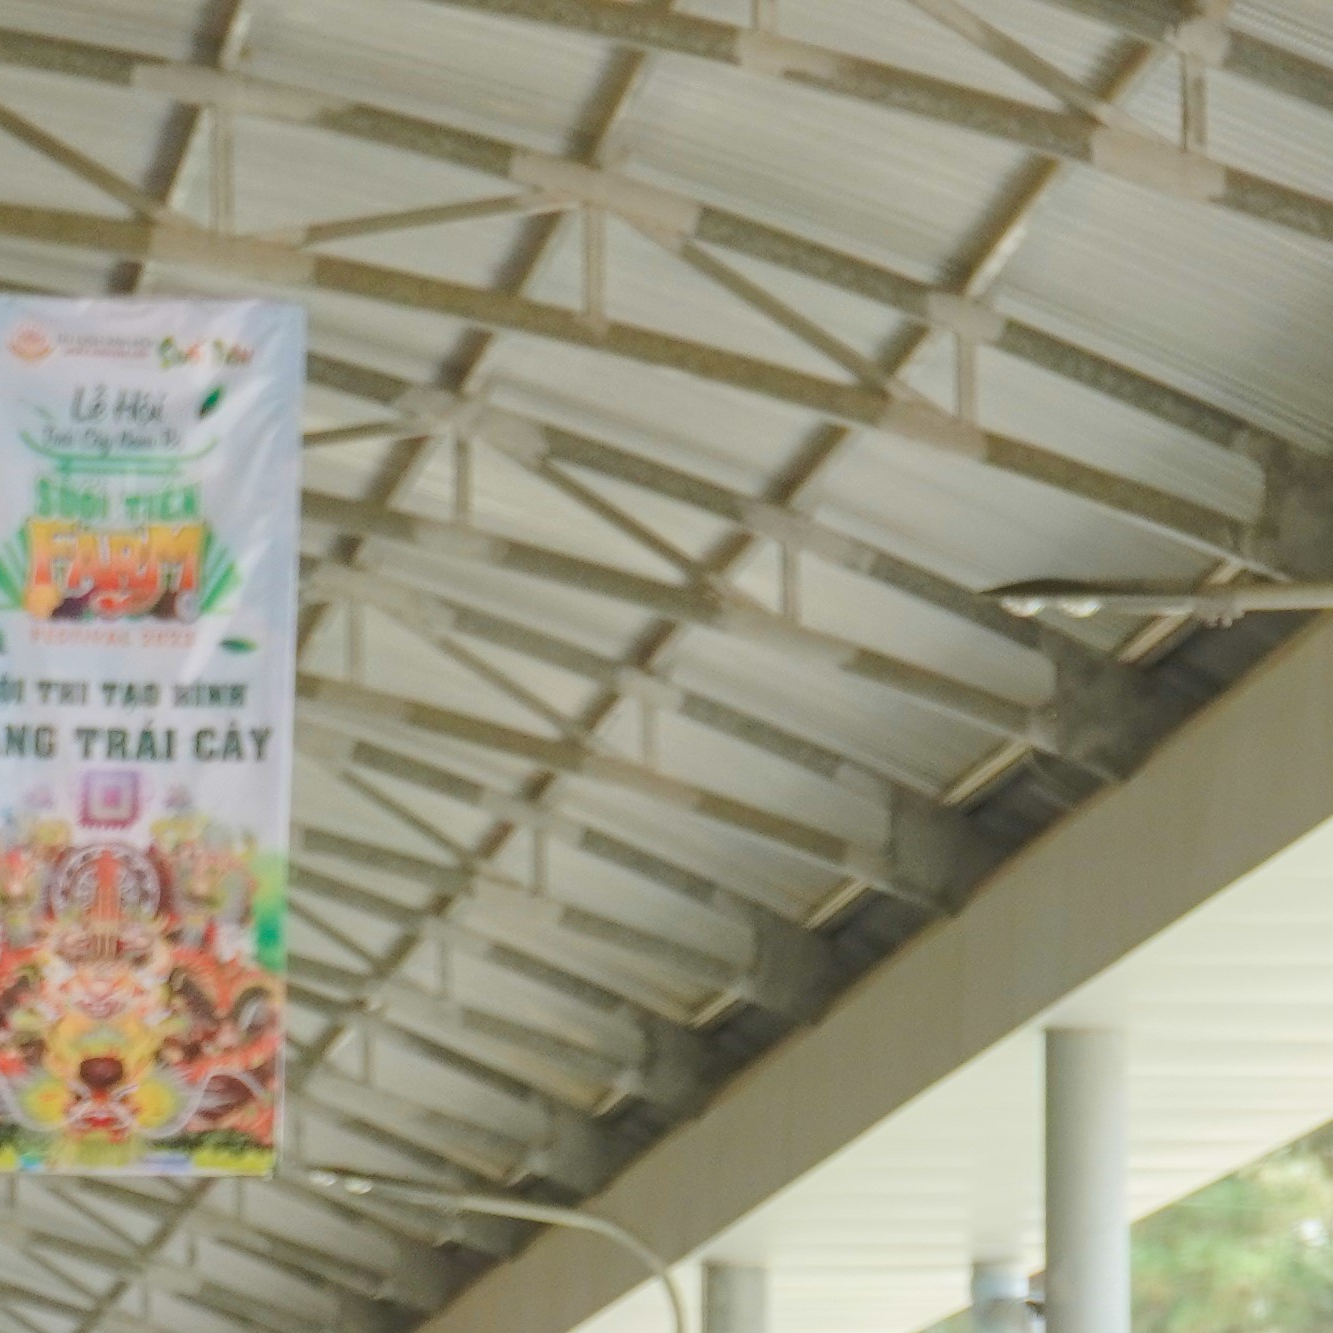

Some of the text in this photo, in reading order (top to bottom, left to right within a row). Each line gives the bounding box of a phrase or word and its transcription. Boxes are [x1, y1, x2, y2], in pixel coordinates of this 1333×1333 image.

[27, 517, 202, 591] FARM
[75, 718, 176, 761] TRÁI
[195, 717, 271, 761] CÂY
